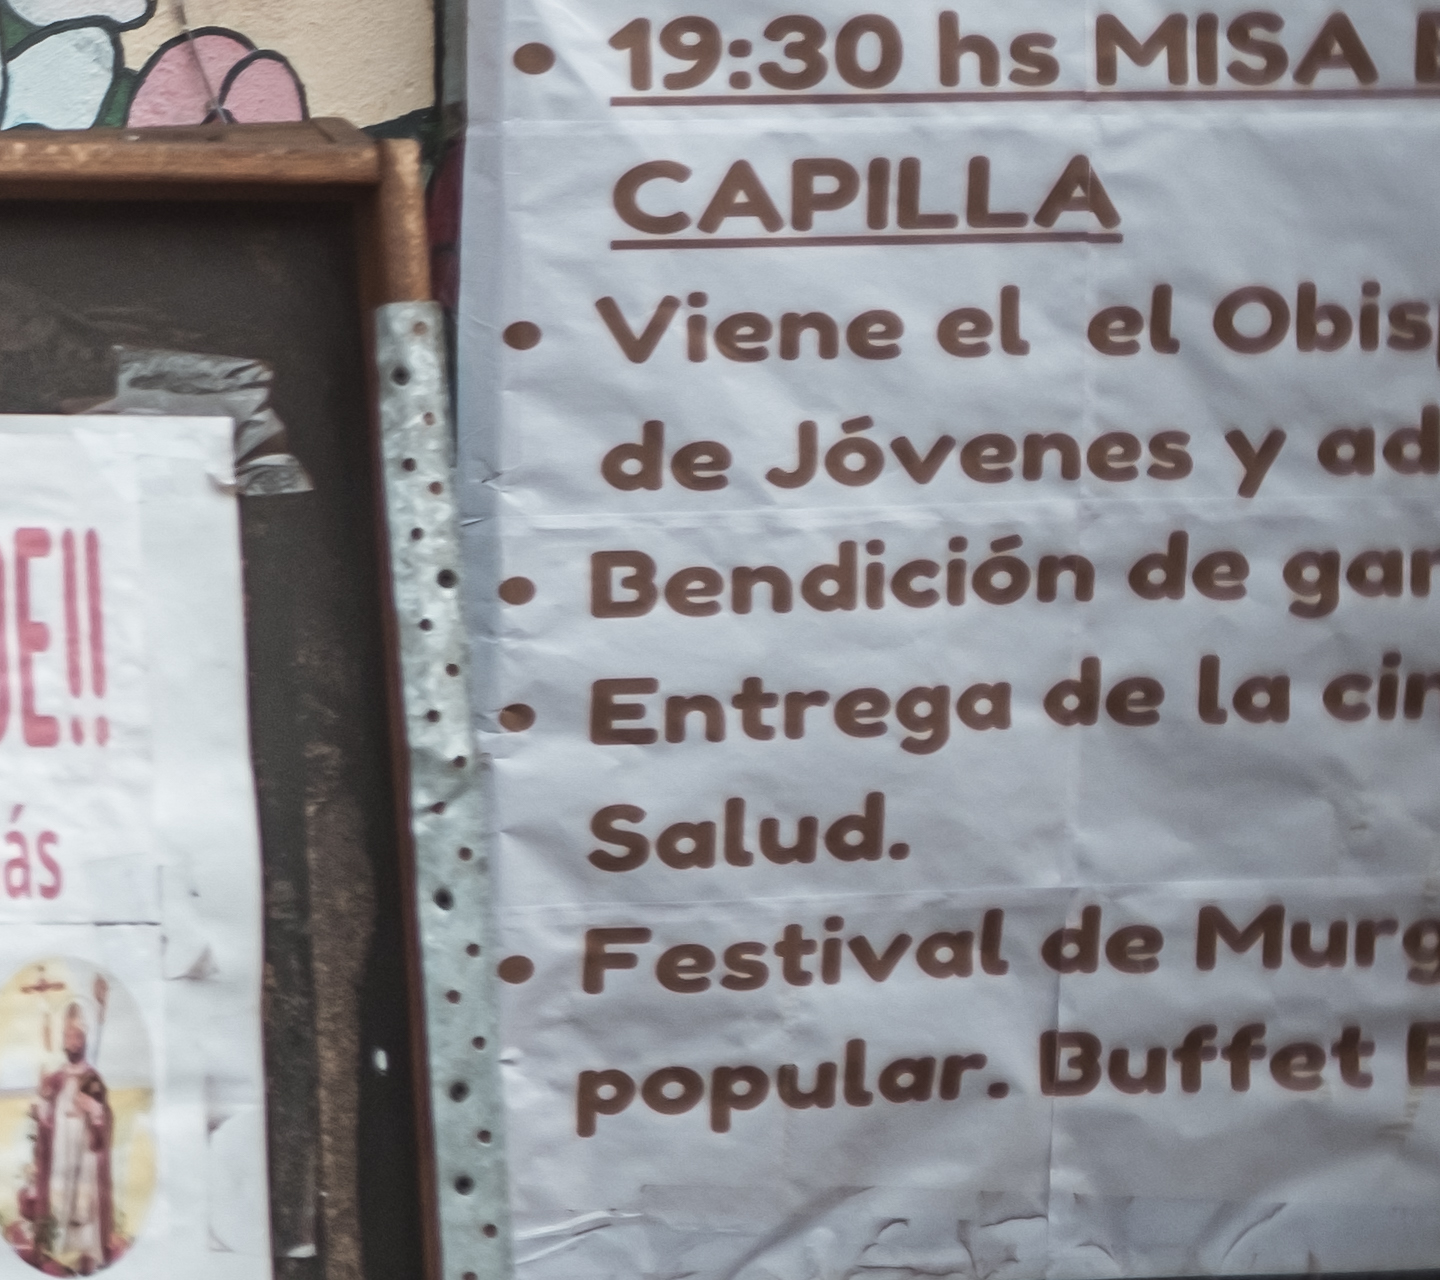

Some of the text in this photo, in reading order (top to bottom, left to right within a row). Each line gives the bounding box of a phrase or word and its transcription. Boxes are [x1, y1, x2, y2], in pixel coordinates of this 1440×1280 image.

[607, 11, 904, 93] 19:30
[937, 8, 1062, 90] hs
[1093, 9, 1379, 90] MISA
[610, 152, 1123, 236] CAPILLA
[593, 279, 1440, 365] Viene el el Obis
[600, 416, 734, 492] de
[765, 408, 1195, 490] Jóvenes
[1224, 426, 1287, 500] y
[588, 532, 1096, 620] Bendición
[1128, 529, 1251, 603] de
[588, 673, 1013, 754] Entrega
[1043, 654, 1167, 728] de
[1198, 653, 1292, 726] la
[587, 792, 910, 873] Salud.
[582, 908, 1010, 995] Festival
[1042, 904, 1165, 975] de
[576, 1037, 1010, 1139] popular.
[1040, 1020, 1376, 1098] Buffet
